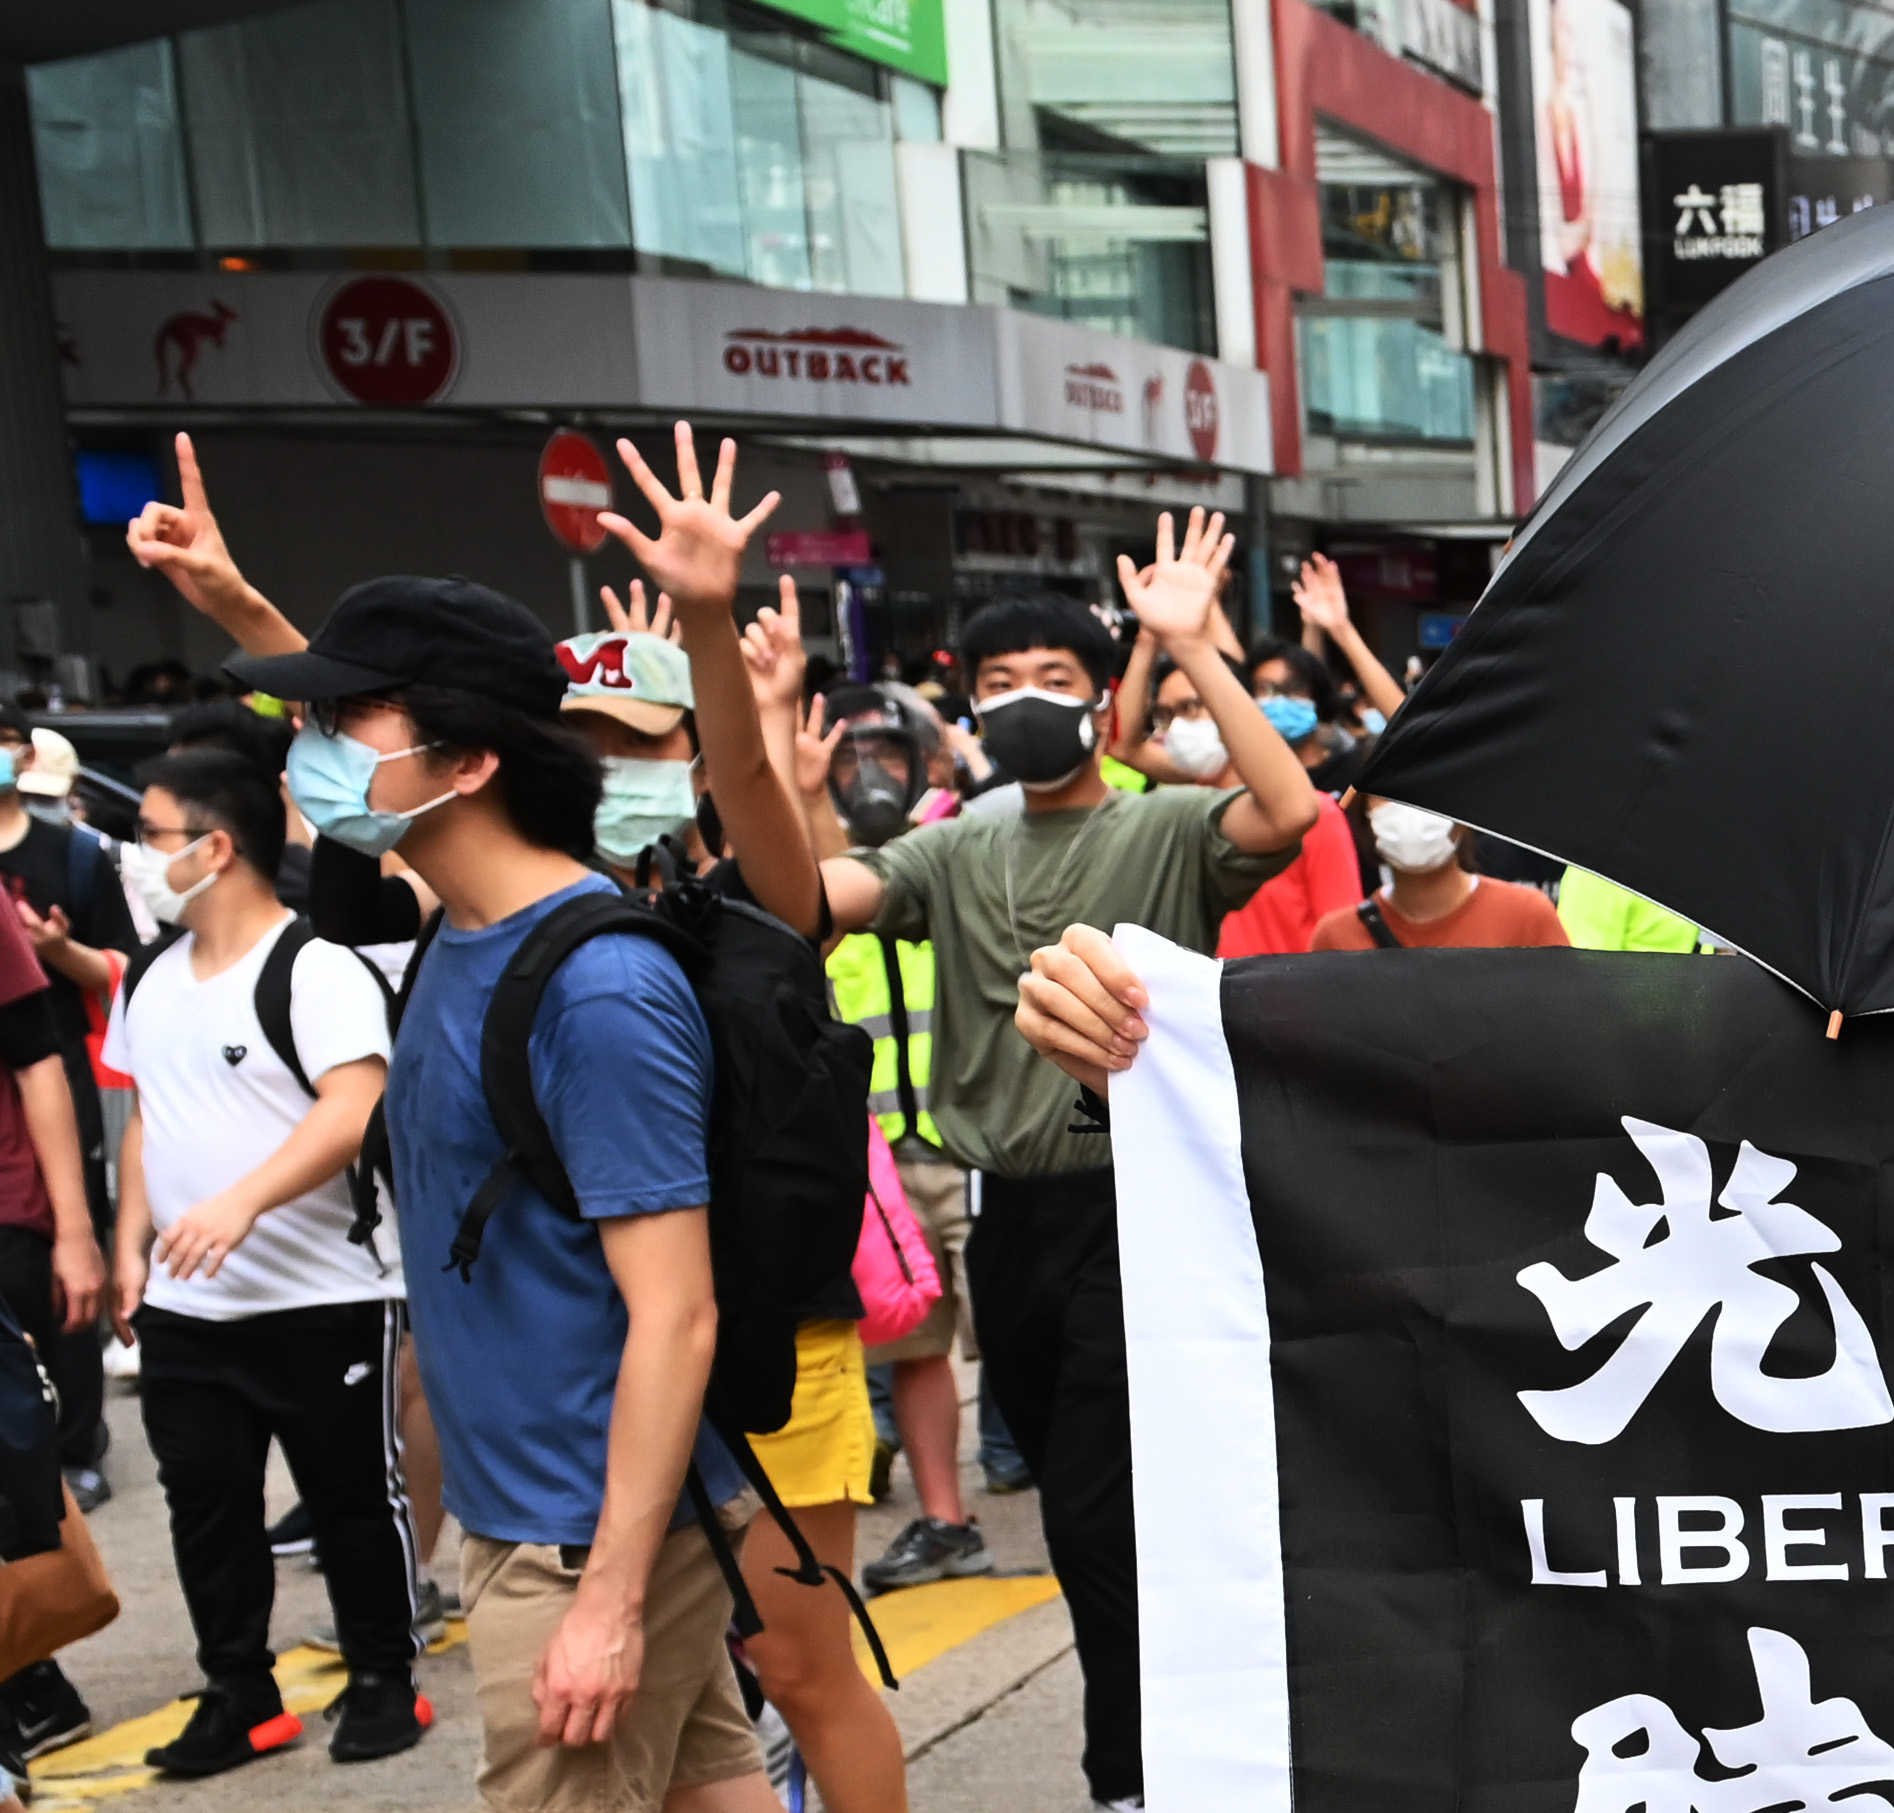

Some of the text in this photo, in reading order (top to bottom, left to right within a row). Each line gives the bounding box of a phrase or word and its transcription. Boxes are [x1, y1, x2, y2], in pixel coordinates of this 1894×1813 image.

[1673, 182, 1765, 235] 六福
[339, 317, 433, 366] 3/F
[723, 345, 911, 386] OUTBACK
